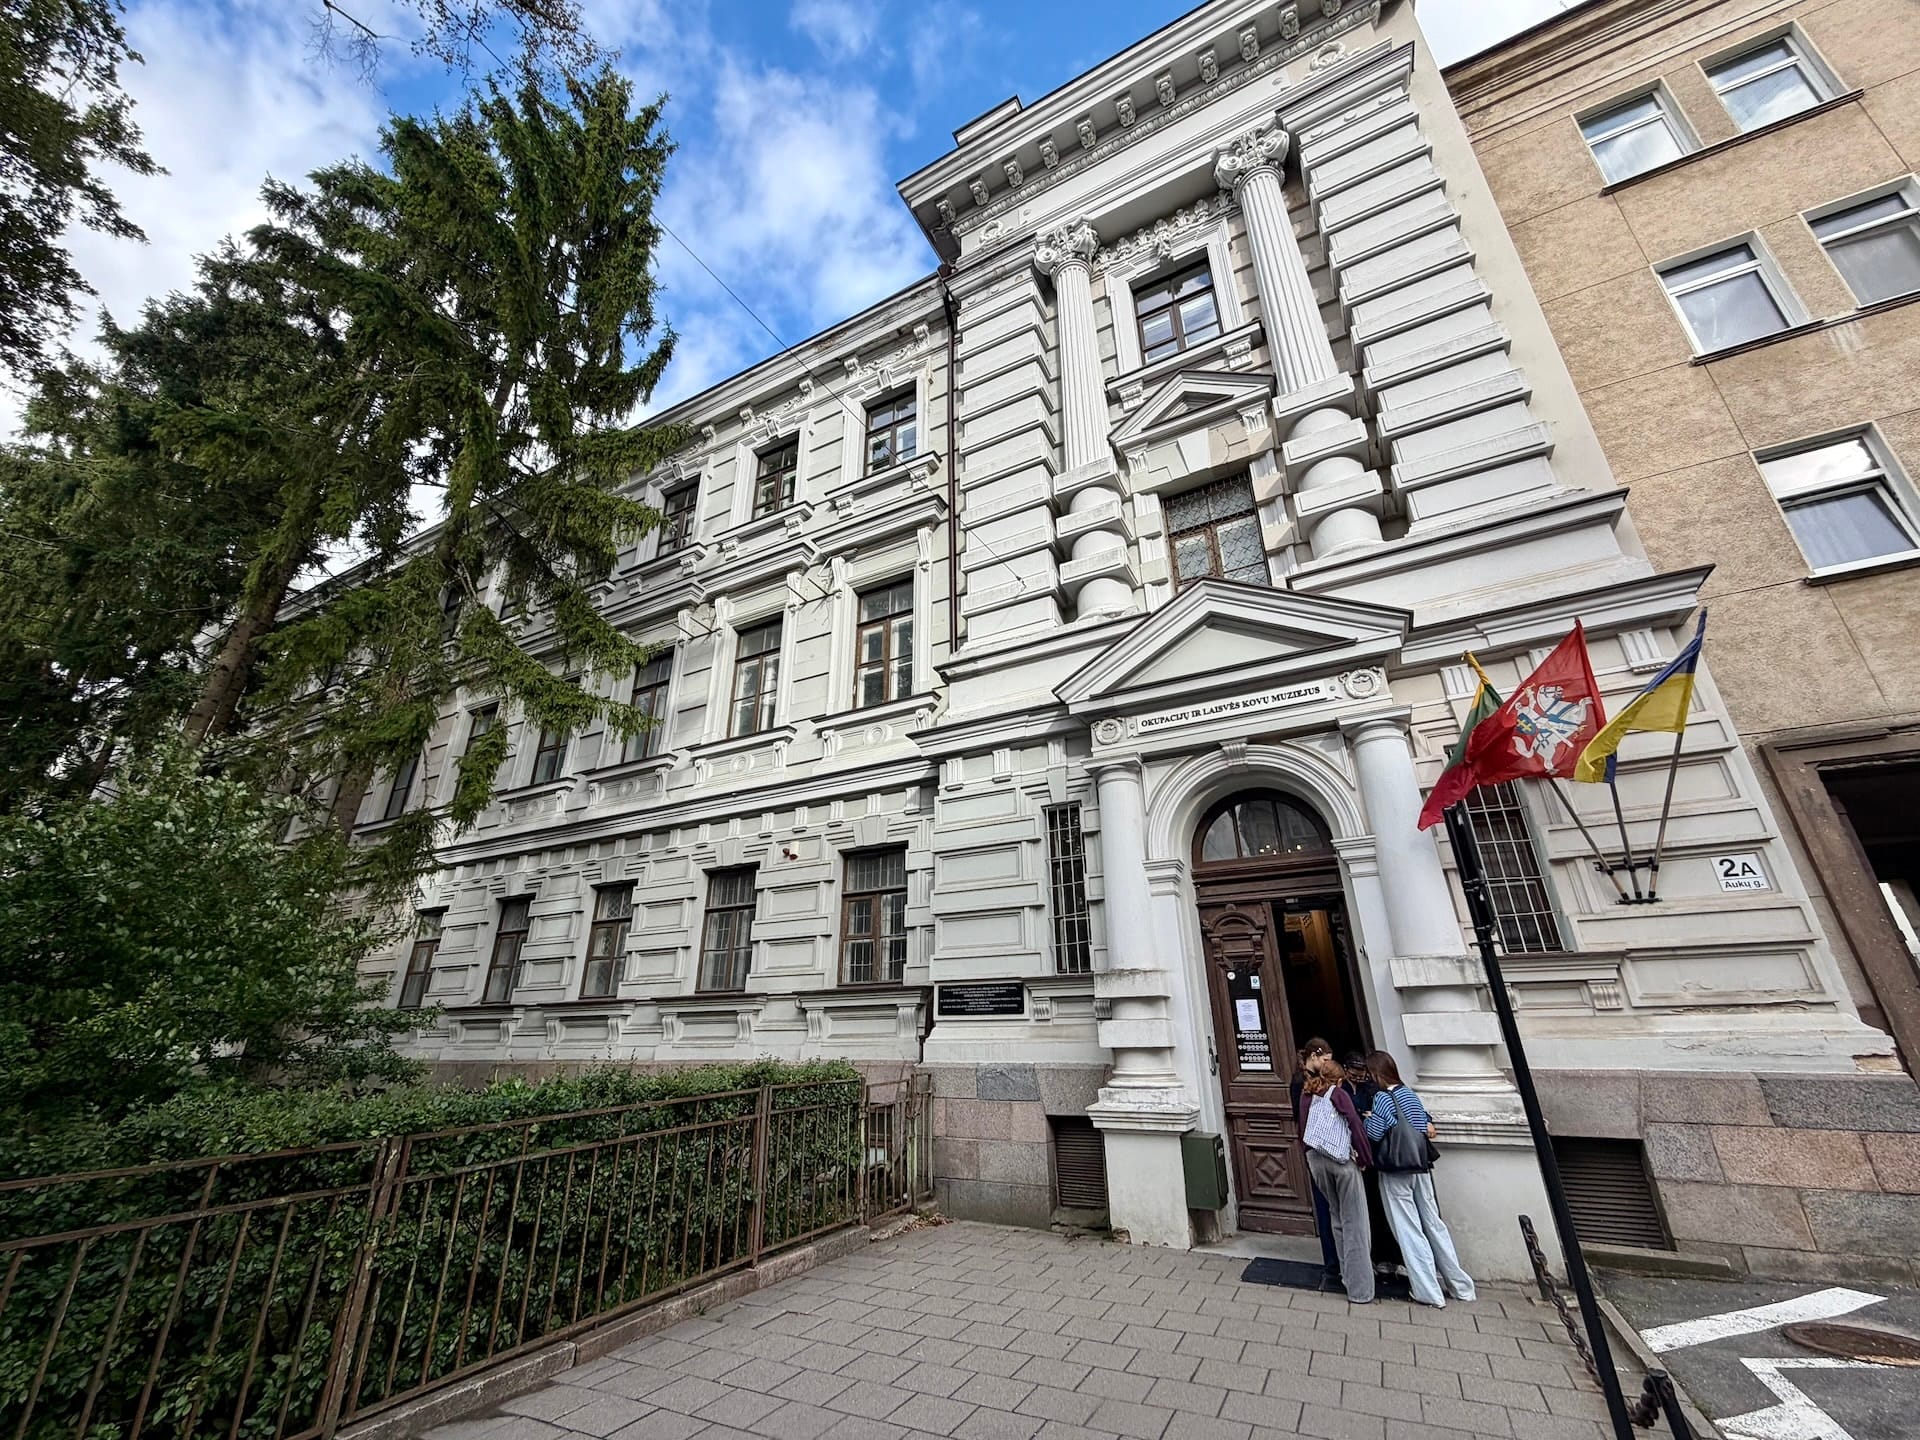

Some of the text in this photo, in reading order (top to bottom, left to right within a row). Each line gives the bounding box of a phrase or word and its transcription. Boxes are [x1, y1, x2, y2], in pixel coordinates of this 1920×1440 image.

[1141, 686, 1320, 727] OKUPACIJŲ IR LAISVĖS KOVŲ MUZIEJUS
[1719, 858, 1757, 878] 2A
[1725, 880, 1764, 888] Aukų g.
